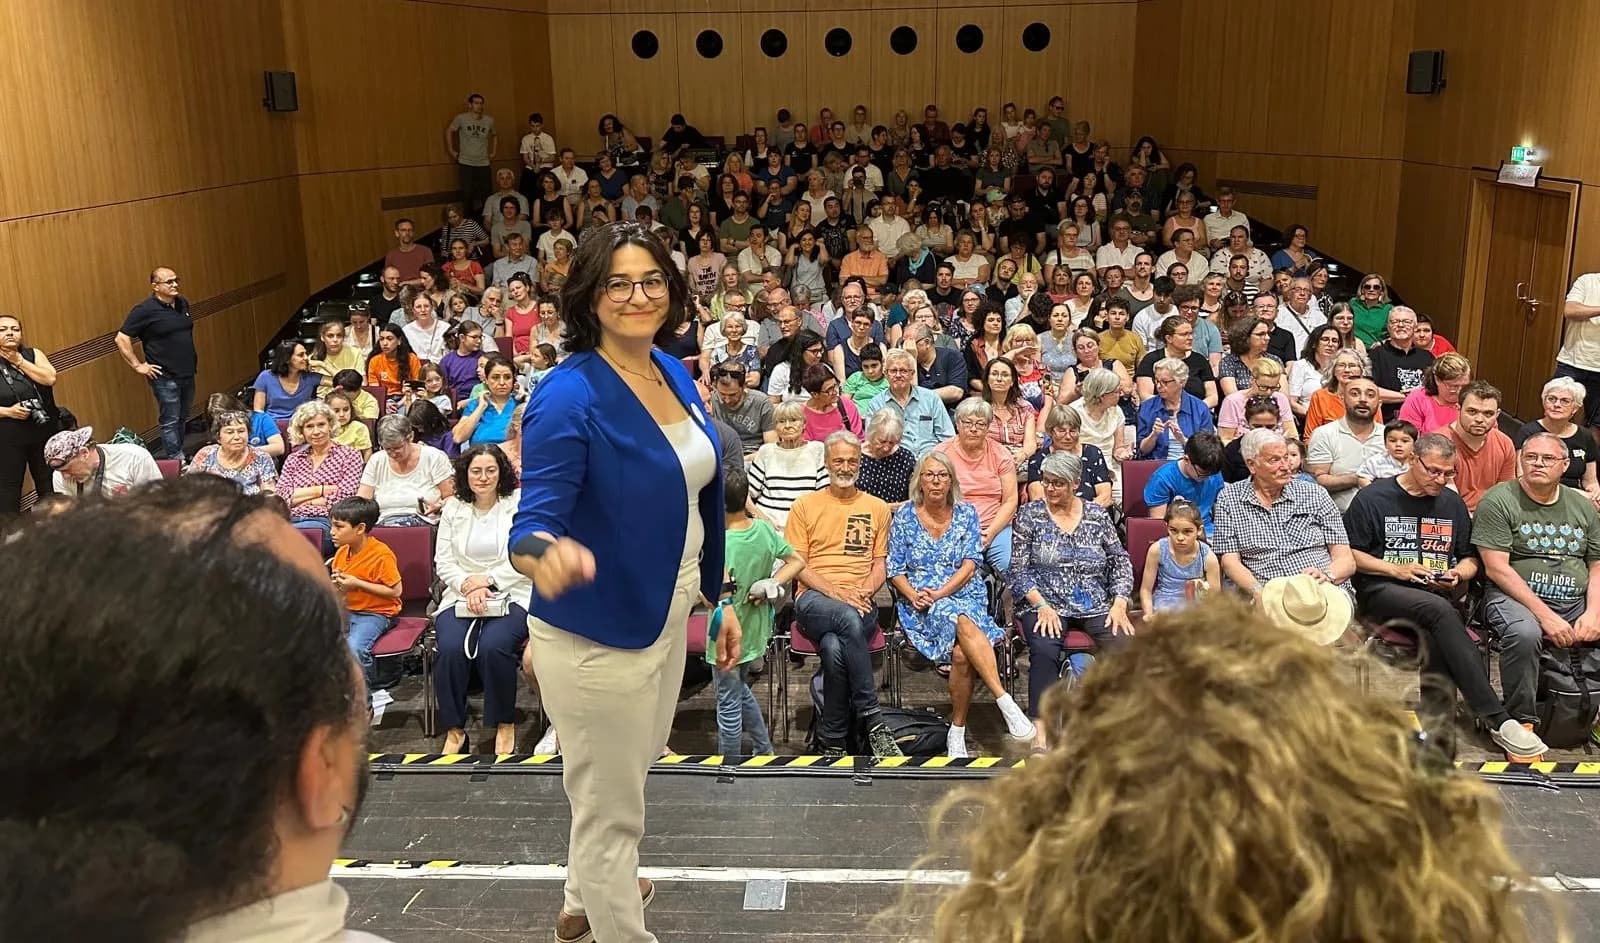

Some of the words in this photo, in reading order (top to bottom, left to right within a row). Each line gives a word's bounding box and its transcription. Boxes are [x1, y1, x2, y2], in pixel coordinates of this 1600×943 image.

[467, 124, 486, 134] NIKE
[1386, 523, 1416, 533] SOPRAN
[1430, 526, 1443, 534] ALT
[1531, 571, 1548, 583] ICH
[1552, 574, 1576, 587] HÖRE
